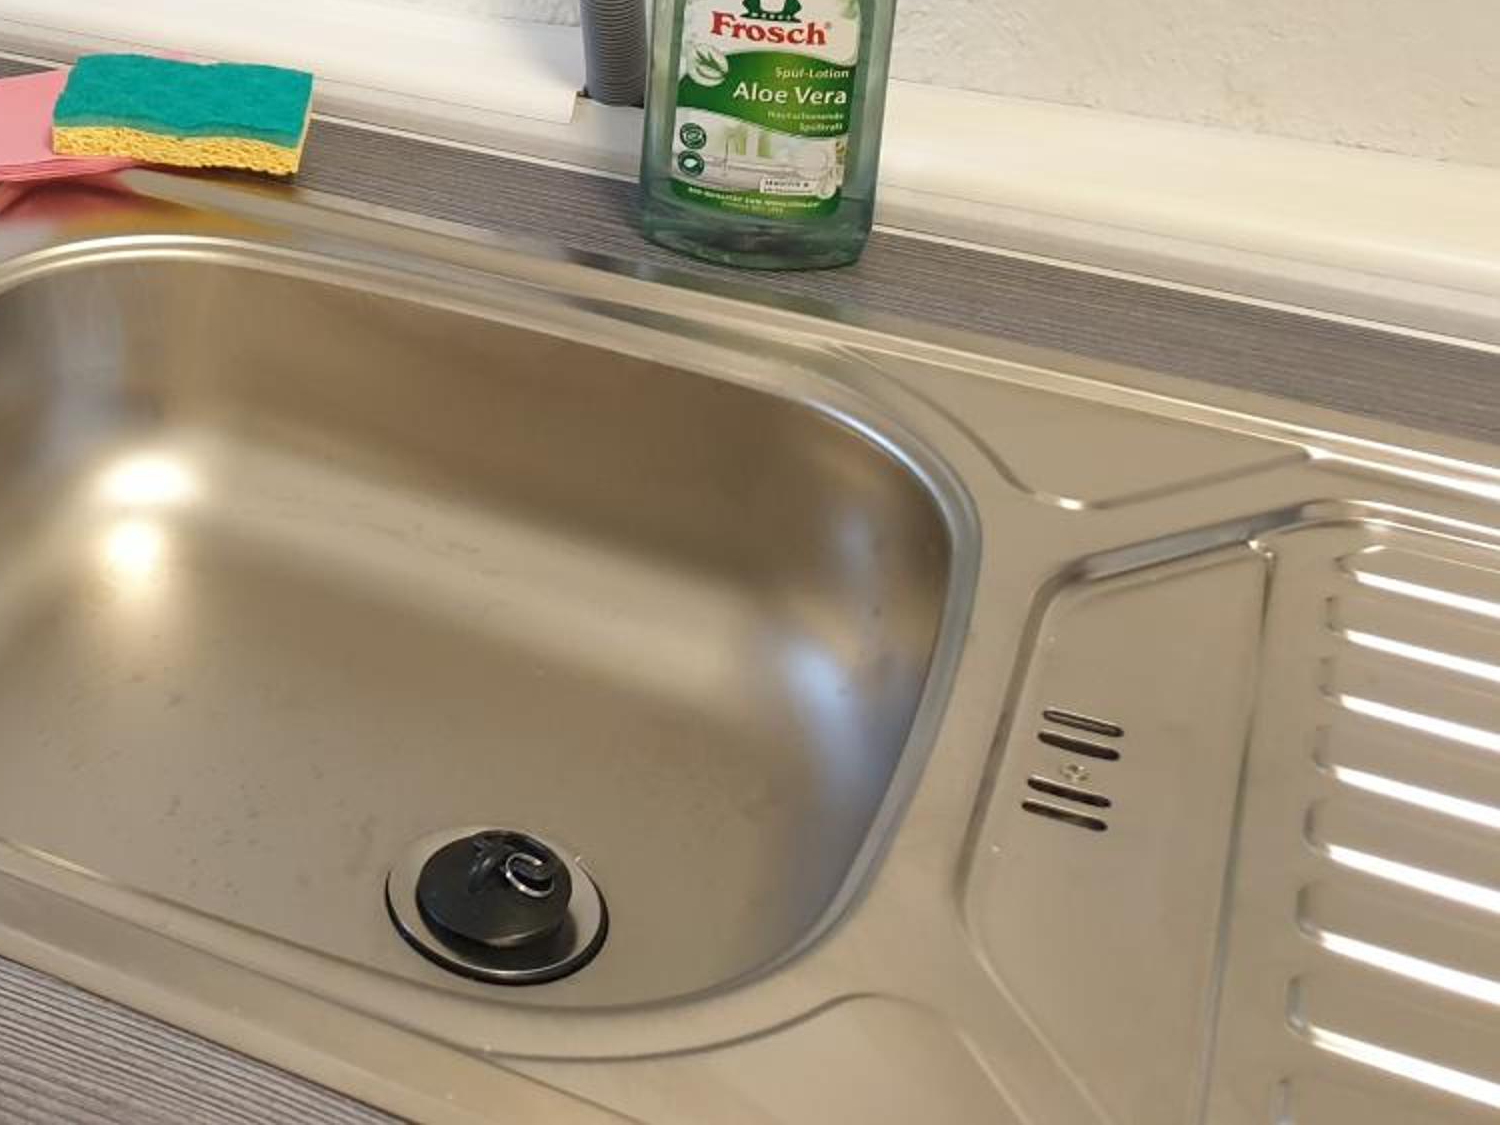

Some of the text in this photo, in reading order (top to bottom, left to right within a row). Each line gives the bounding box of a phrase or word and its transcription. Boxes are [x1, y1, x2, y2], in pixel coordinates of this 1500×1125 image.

[711, 11, 826, 45] Frosch
[733, 82, 847, 104] Aloe Vera
